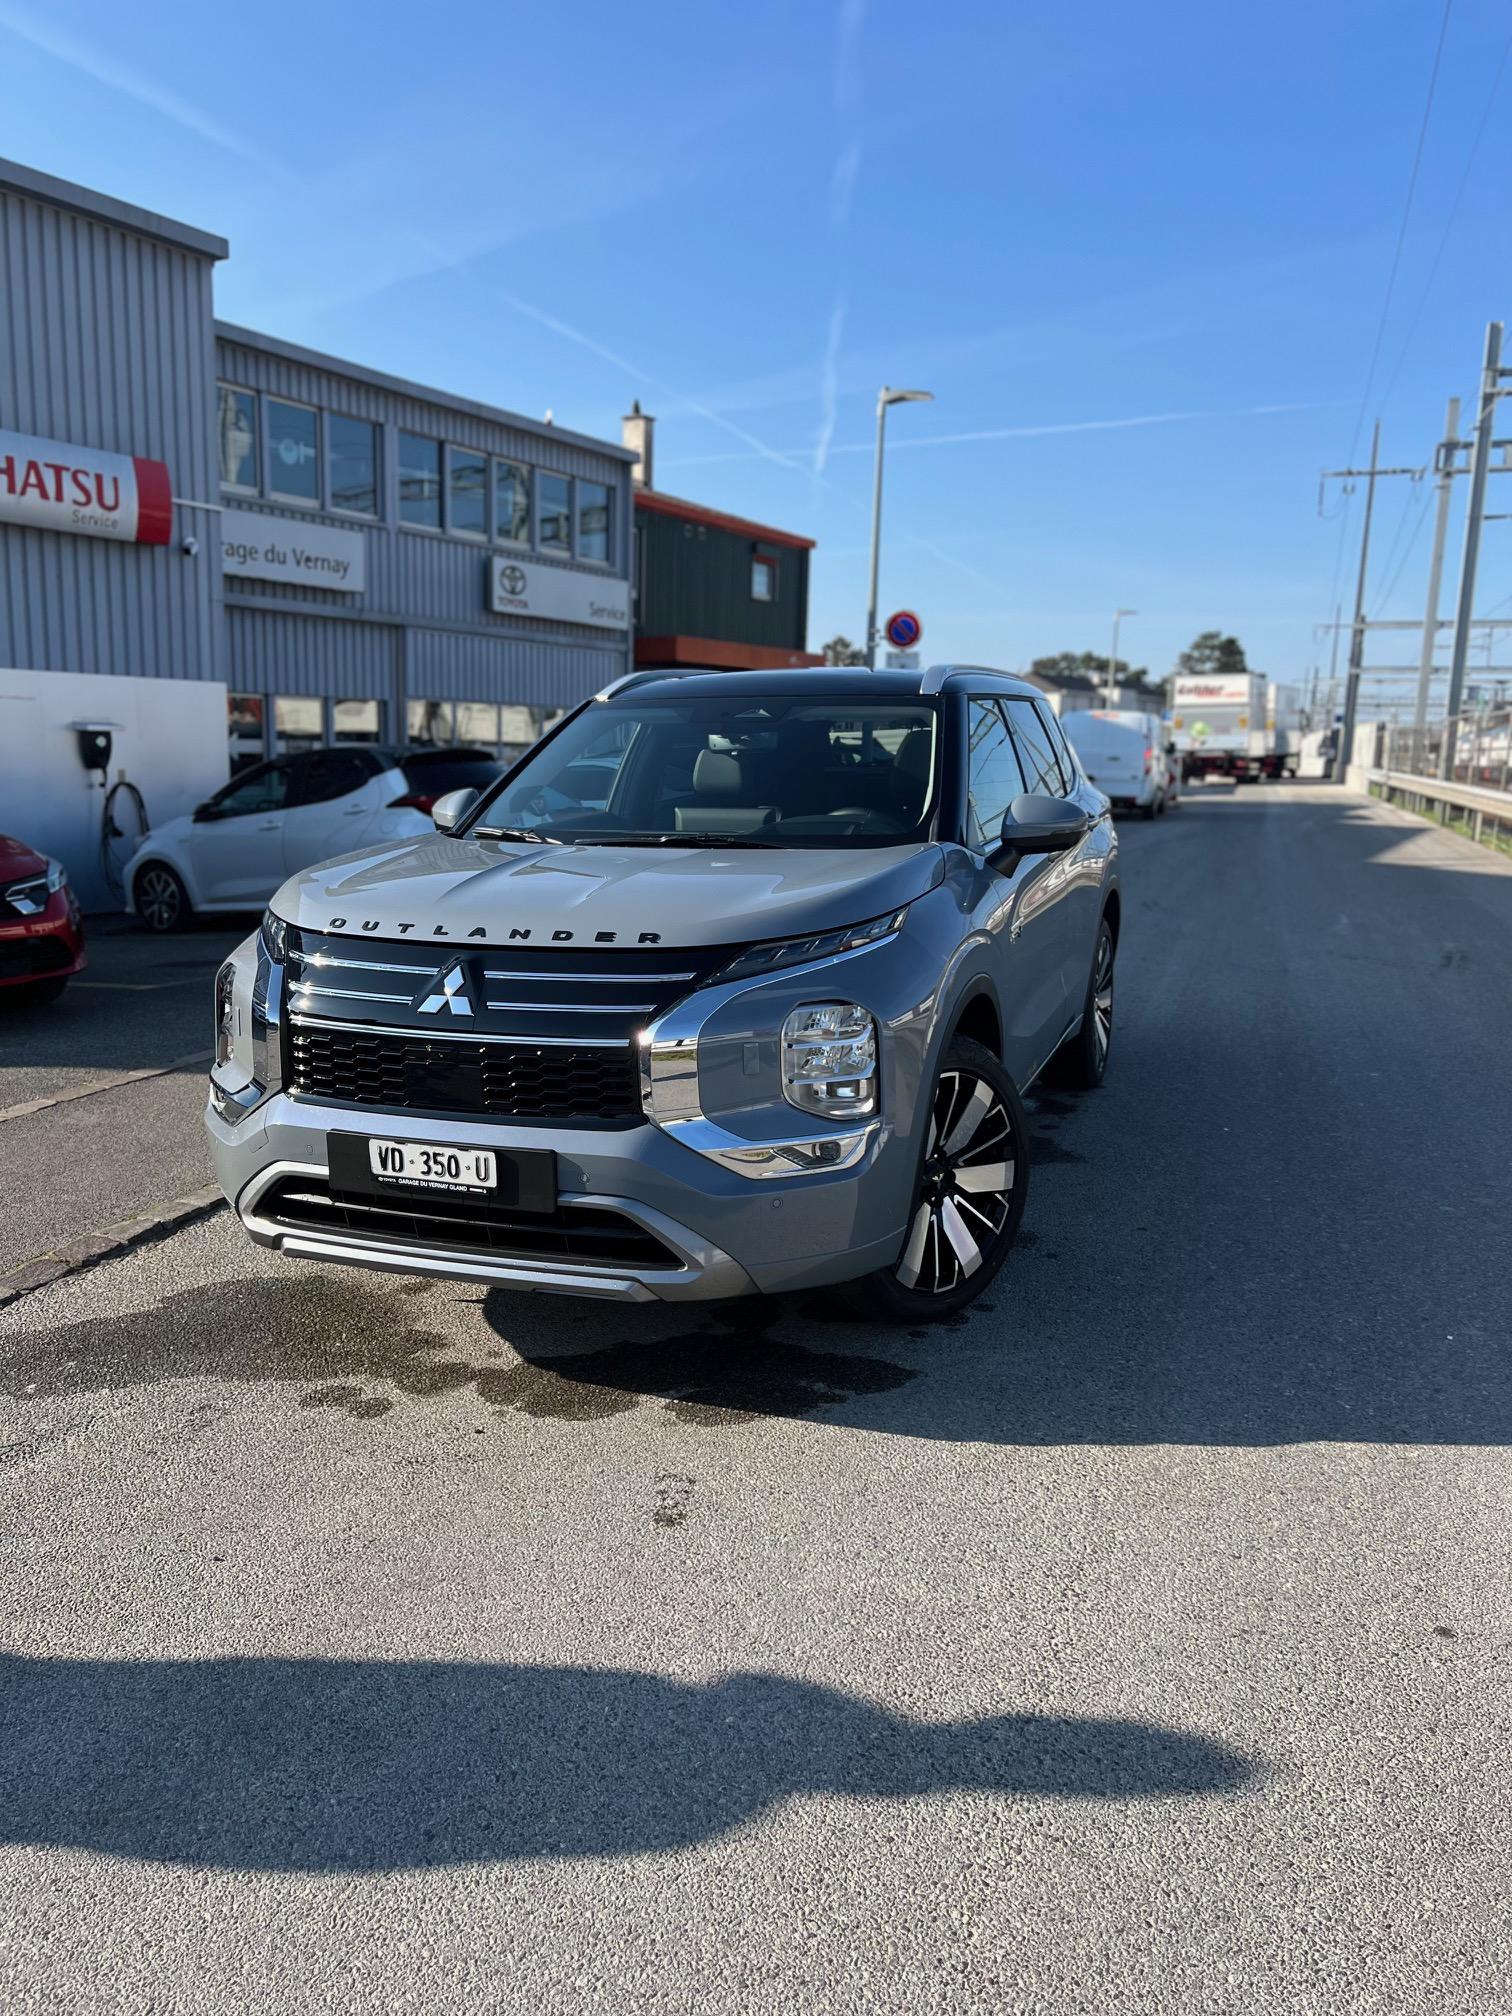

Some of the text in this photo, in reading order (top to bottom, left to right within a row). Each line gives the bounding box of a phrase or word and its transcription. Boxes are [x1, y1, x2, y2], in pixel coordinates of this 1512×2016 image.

[72, 510, 119, 530] Service
[221, 541, 350, 580] age du Vernay
[328, 917, 662, 944] OUTLANDER
[398, 1178, 419, 1186] GARAGE
[429, 1181, 448, 1189] VERNAY
